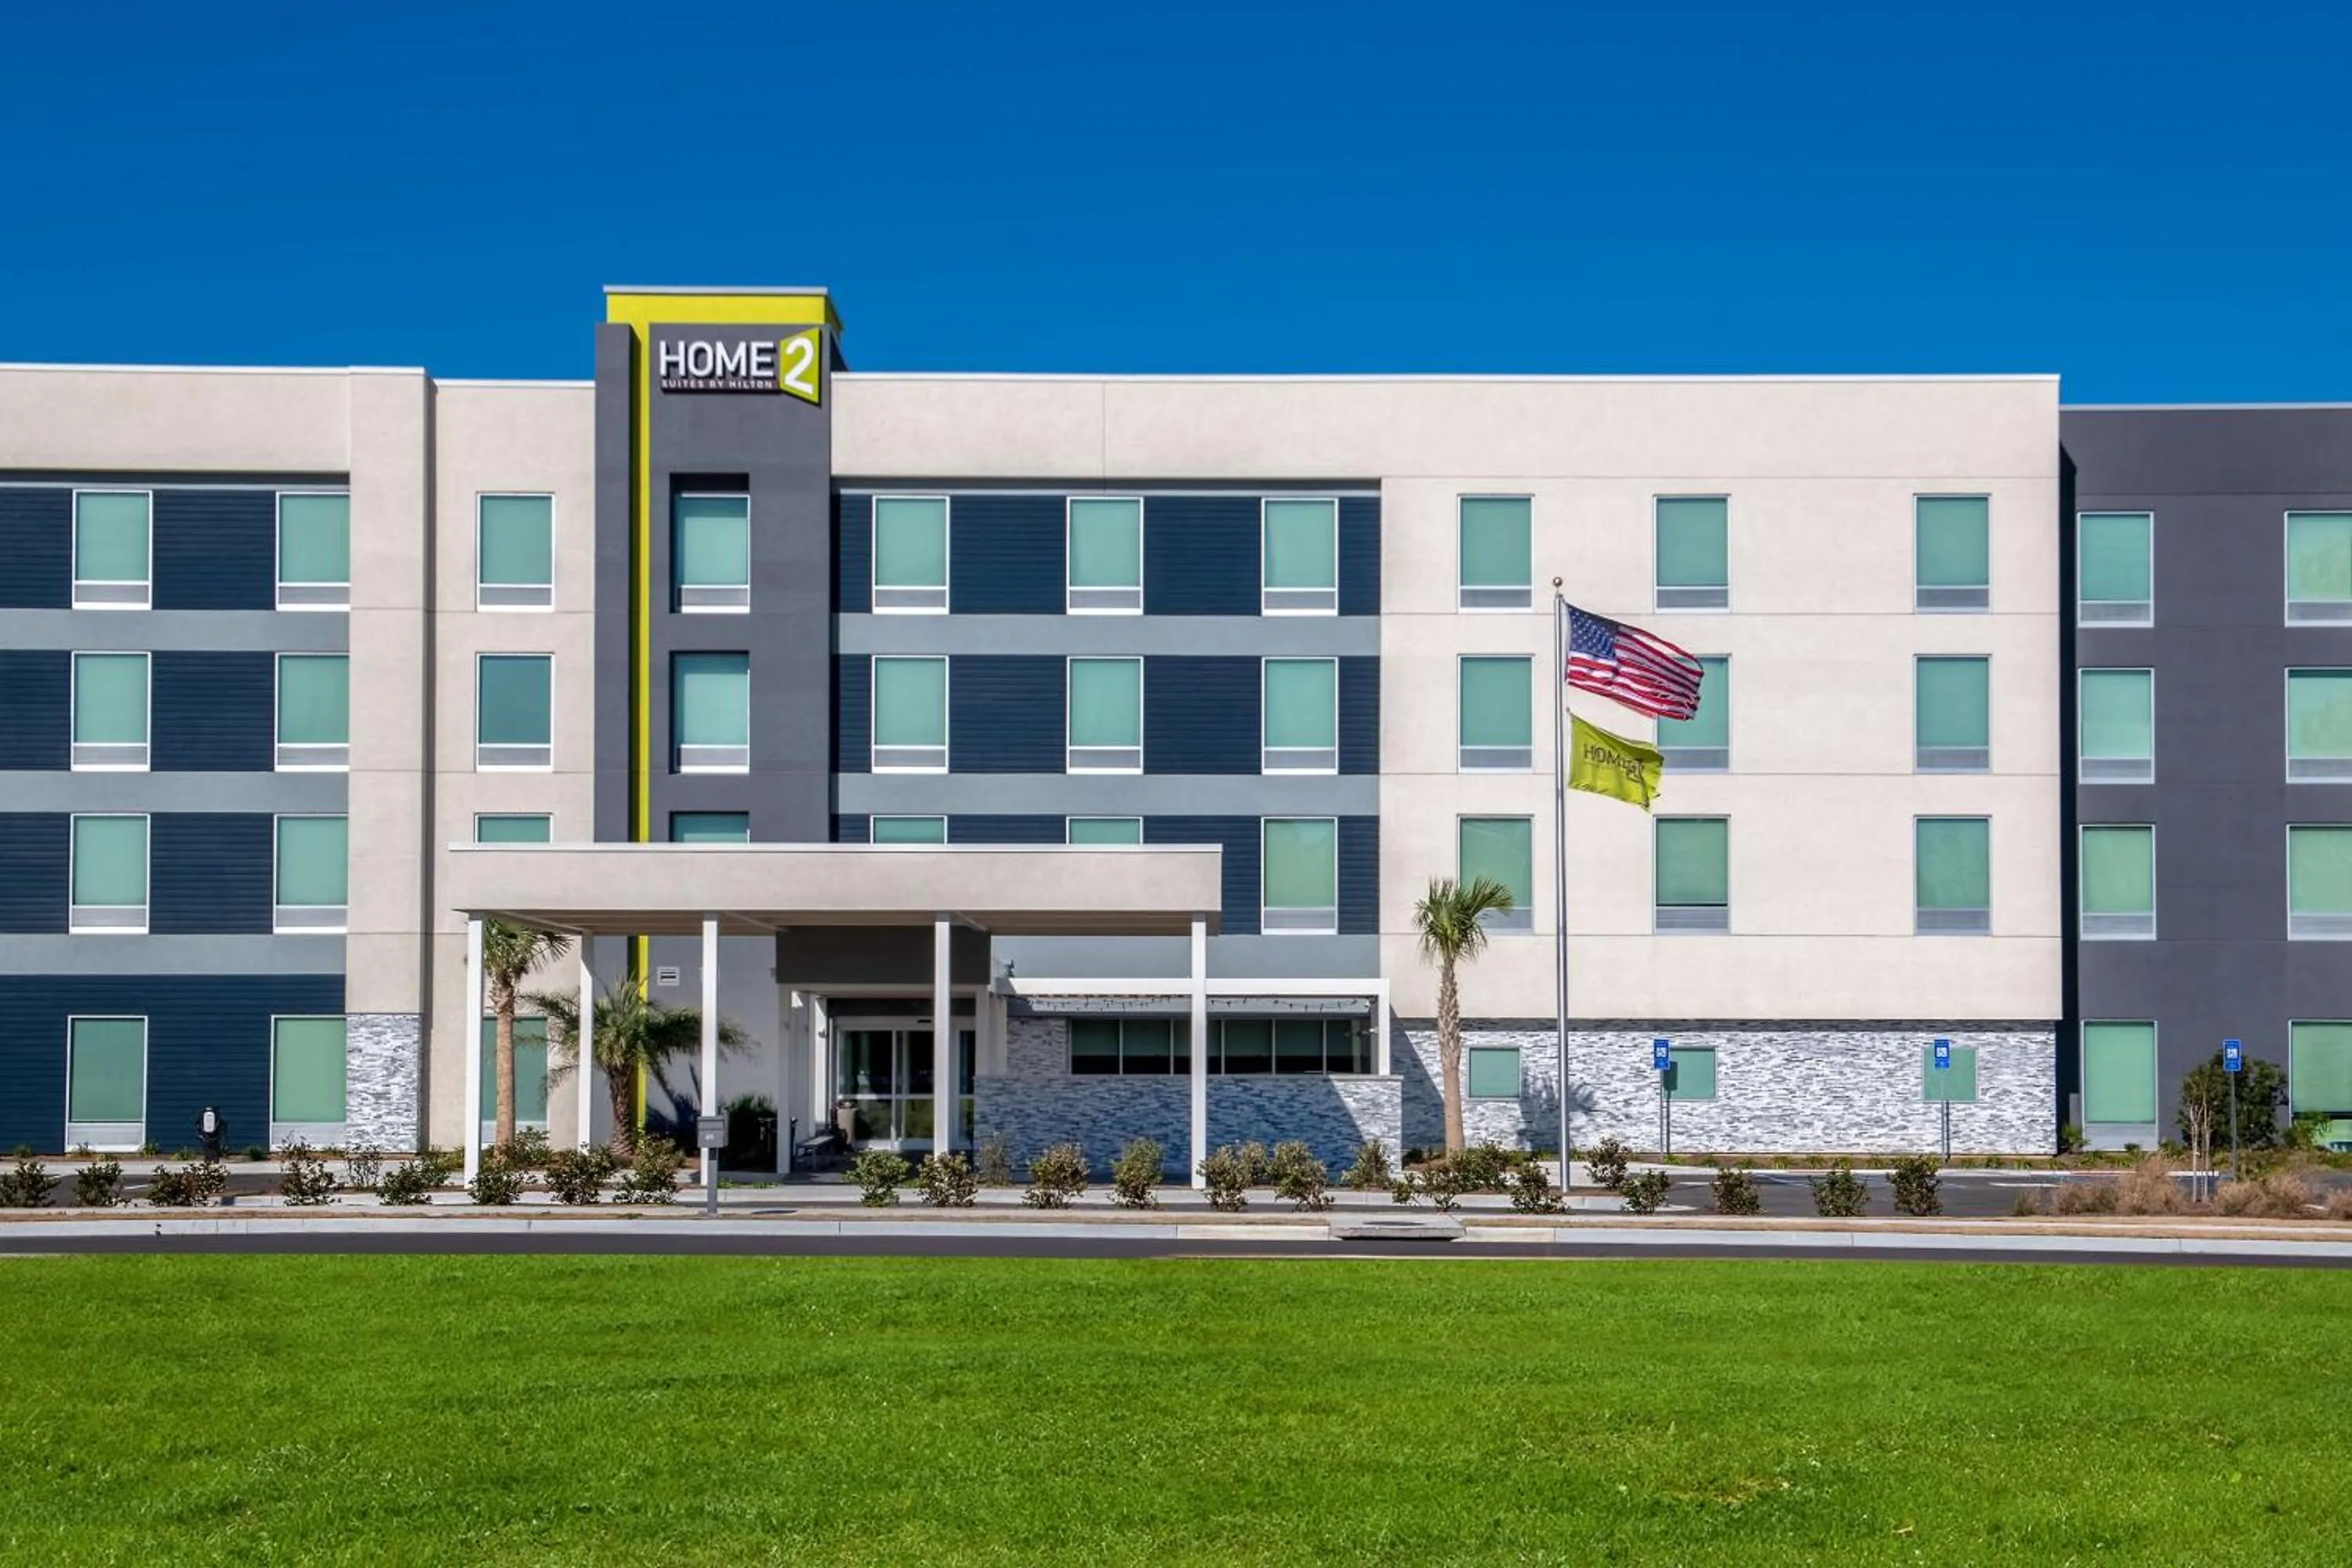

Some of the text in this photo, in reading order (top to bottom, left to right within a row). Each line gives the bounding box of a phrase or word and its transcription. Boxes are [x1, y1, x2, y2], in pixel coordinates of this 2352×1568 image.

[659, 337, 814, 394] HOME 2
[662, 379, 772, 389] SUITES BY HILTON
